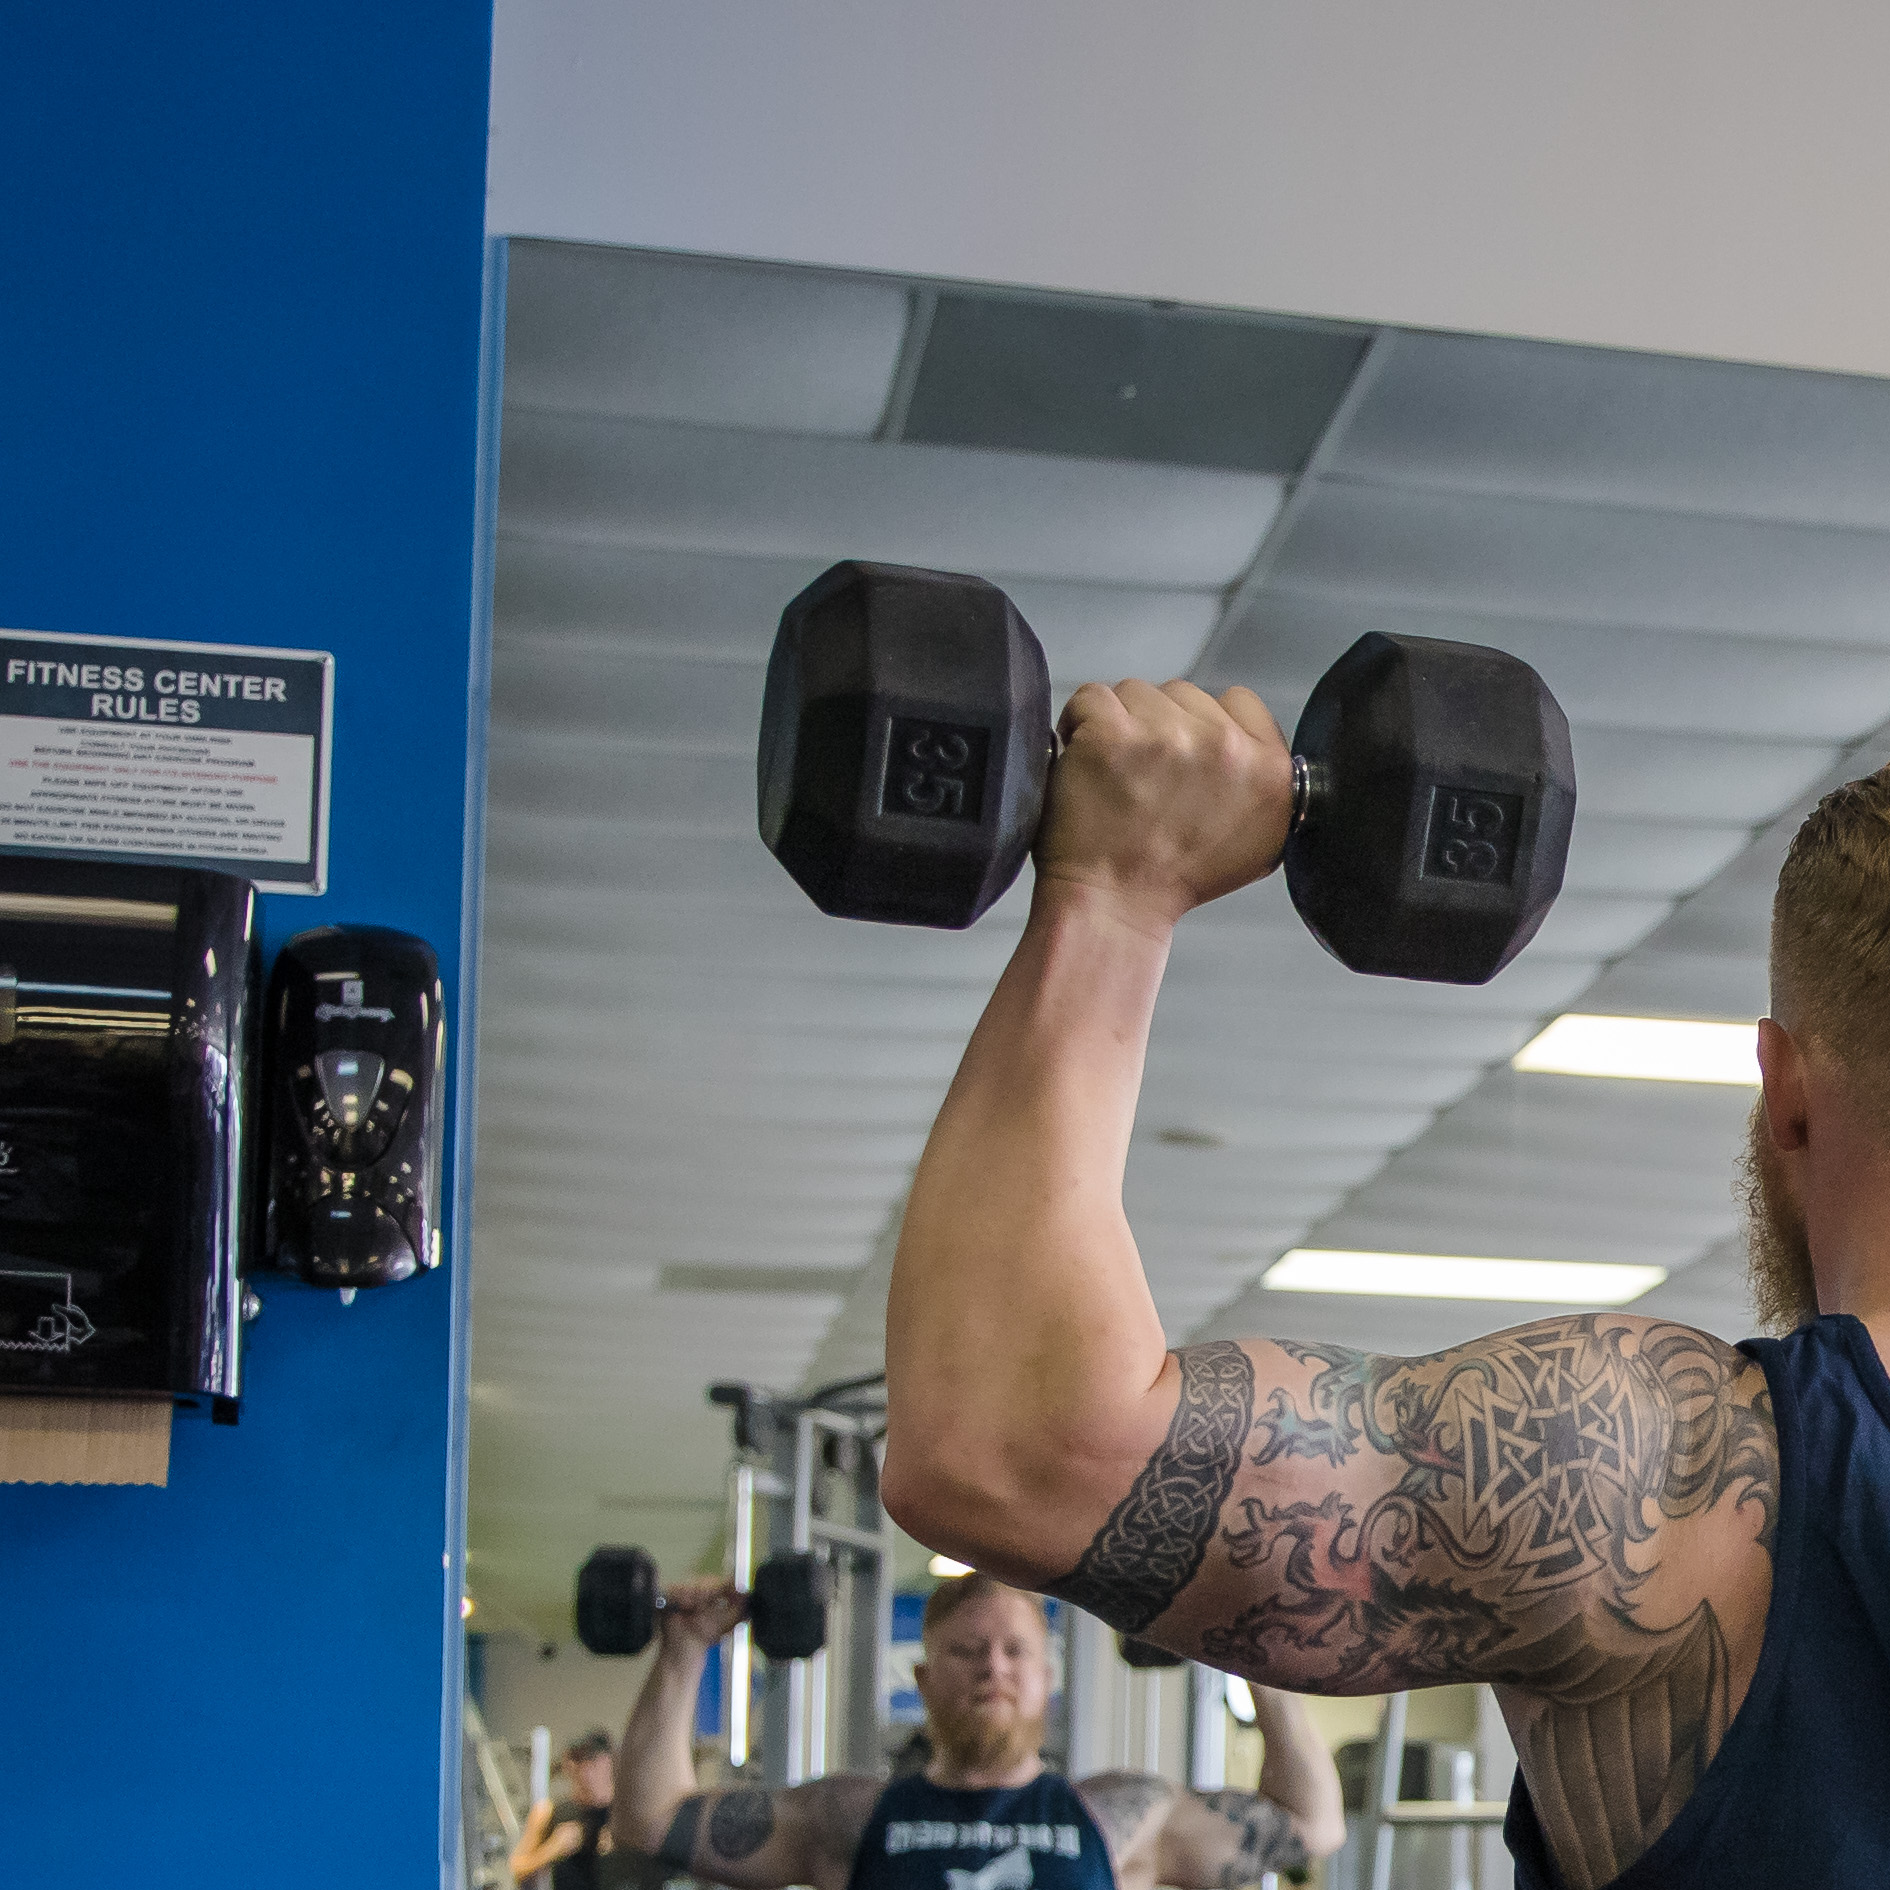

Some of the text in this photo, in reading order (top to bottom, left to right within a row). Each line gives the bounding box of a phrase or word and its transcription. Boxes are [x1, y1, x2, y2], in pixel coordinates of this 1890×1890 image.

[7, 659, 288, 702] FITNESS CENTER
[91, 693, 201, 724] RULES
[904, 728, 970, 815] 35
[1444, 796, 1506, 878] 35
